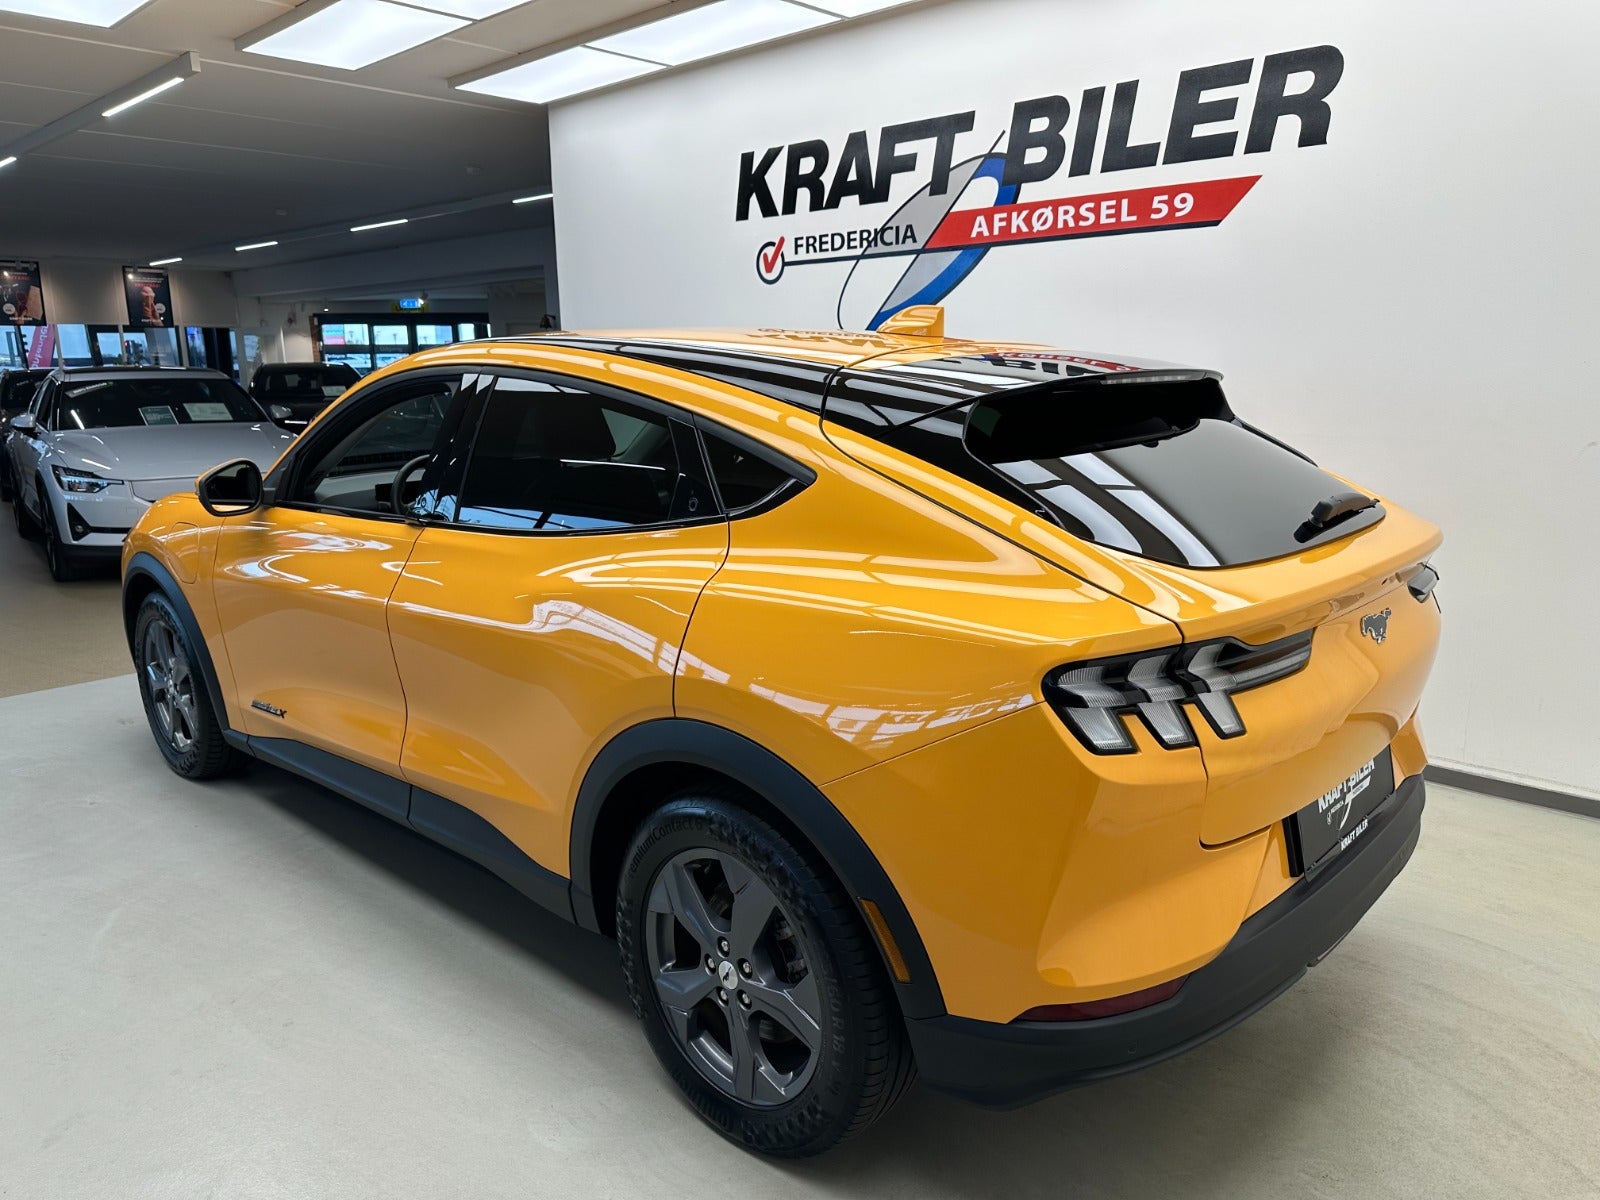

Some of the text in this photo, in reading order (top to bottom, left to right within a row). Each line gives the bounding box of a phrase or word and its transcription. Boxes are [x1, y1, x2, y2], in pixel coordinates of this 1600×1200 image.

[735, 44, 1344, 221] KRAFT BILER
[970, 192, 1194, 238] AFKØRSEL 59
[794, 224, 917, 255] FREDERICIA
